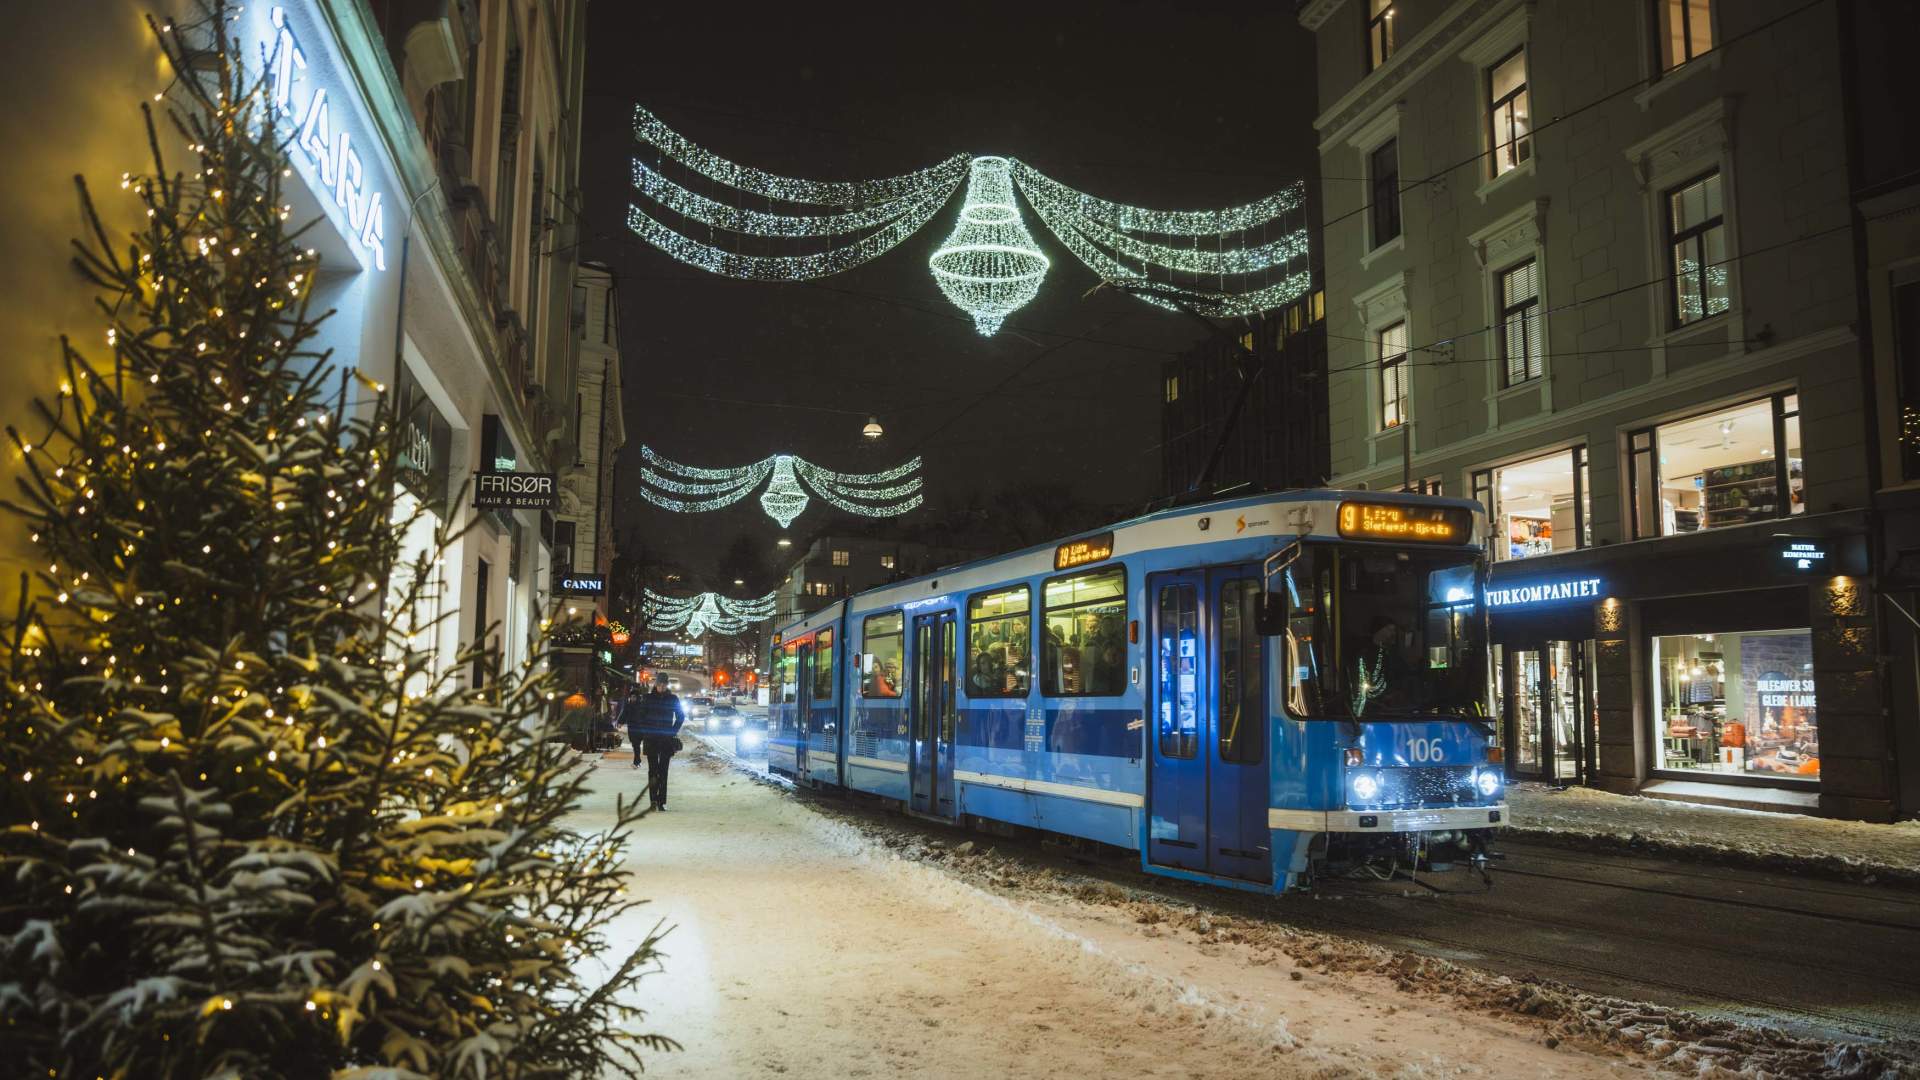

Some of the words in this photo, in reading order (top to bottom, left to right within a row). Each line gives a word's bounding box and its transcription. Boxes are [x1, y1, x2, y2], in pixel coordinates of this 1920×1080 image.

[480, 476, 552, 494] FRISØR
[516, 498, 551, 506] BEAUTY
[563, 579, 602, 590] GANNI
[1486, 579, 1600, 607] TURKOMPANIET
[1802, 680, 1815, 692] SO
[1407, 738, 1444, 762] 106
